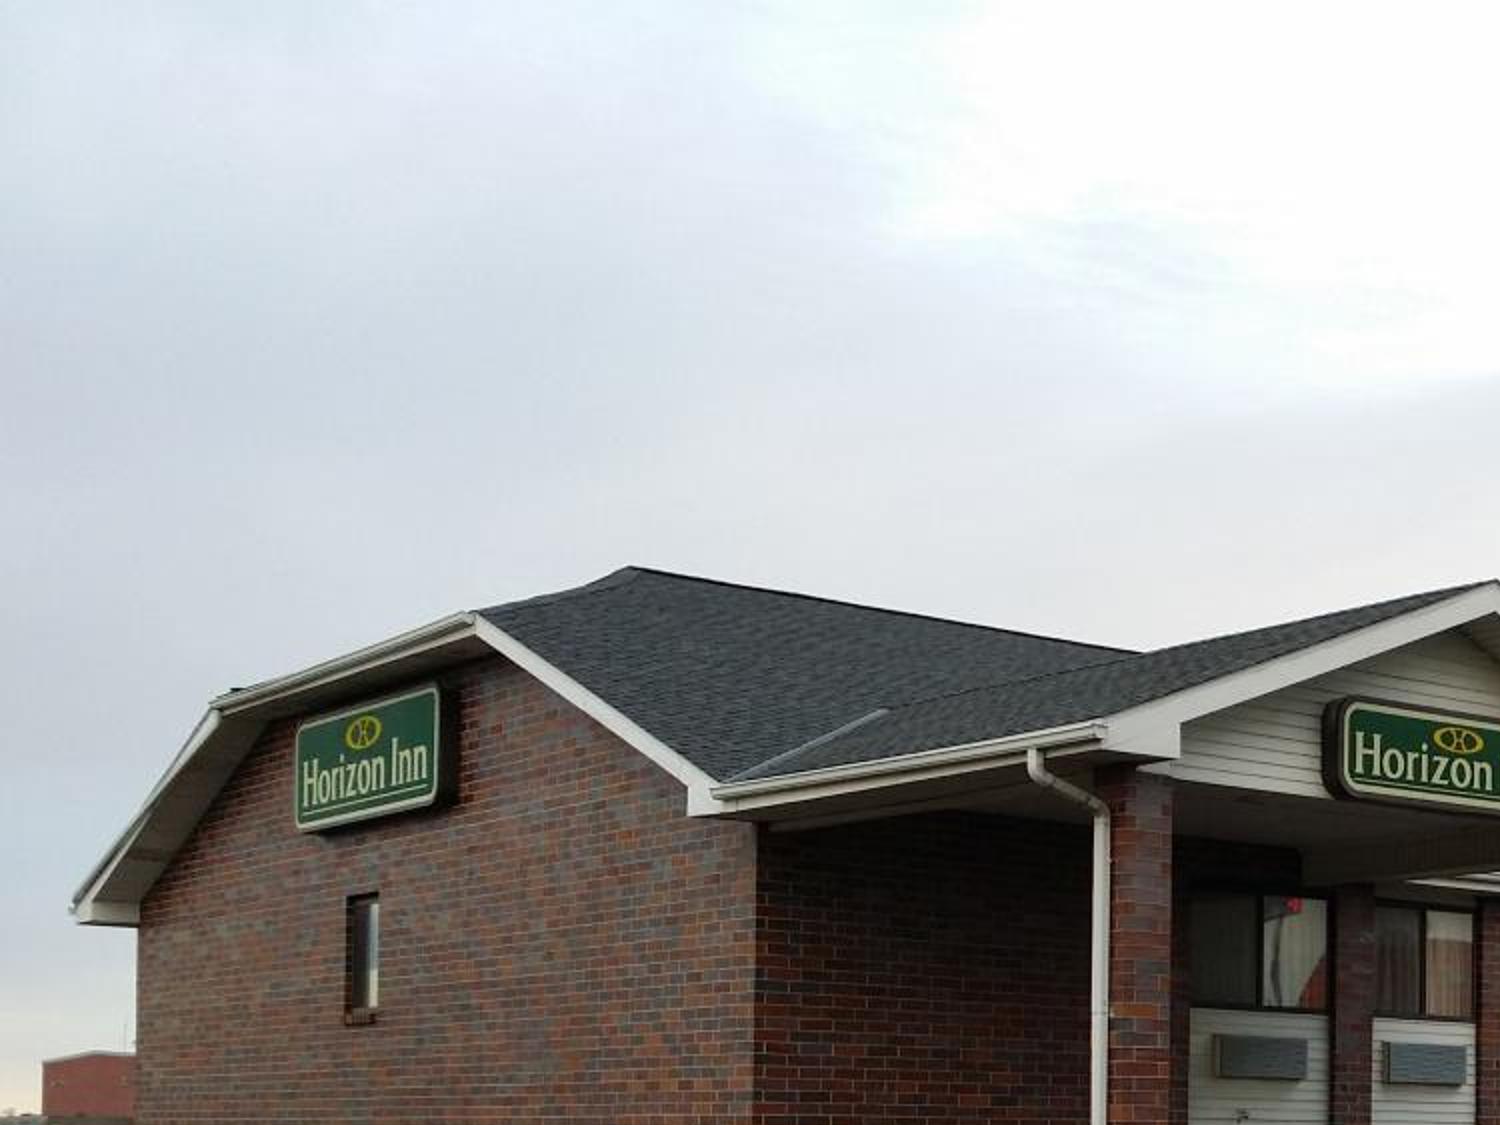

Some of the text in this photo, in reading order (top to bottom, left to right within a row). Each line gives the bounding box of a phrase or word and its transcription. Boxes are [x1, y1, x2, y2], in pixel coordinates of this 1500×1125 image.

[303, 737, 428, 807] Horizon Inn
[1354, 731, 1493, 791] Horizon
